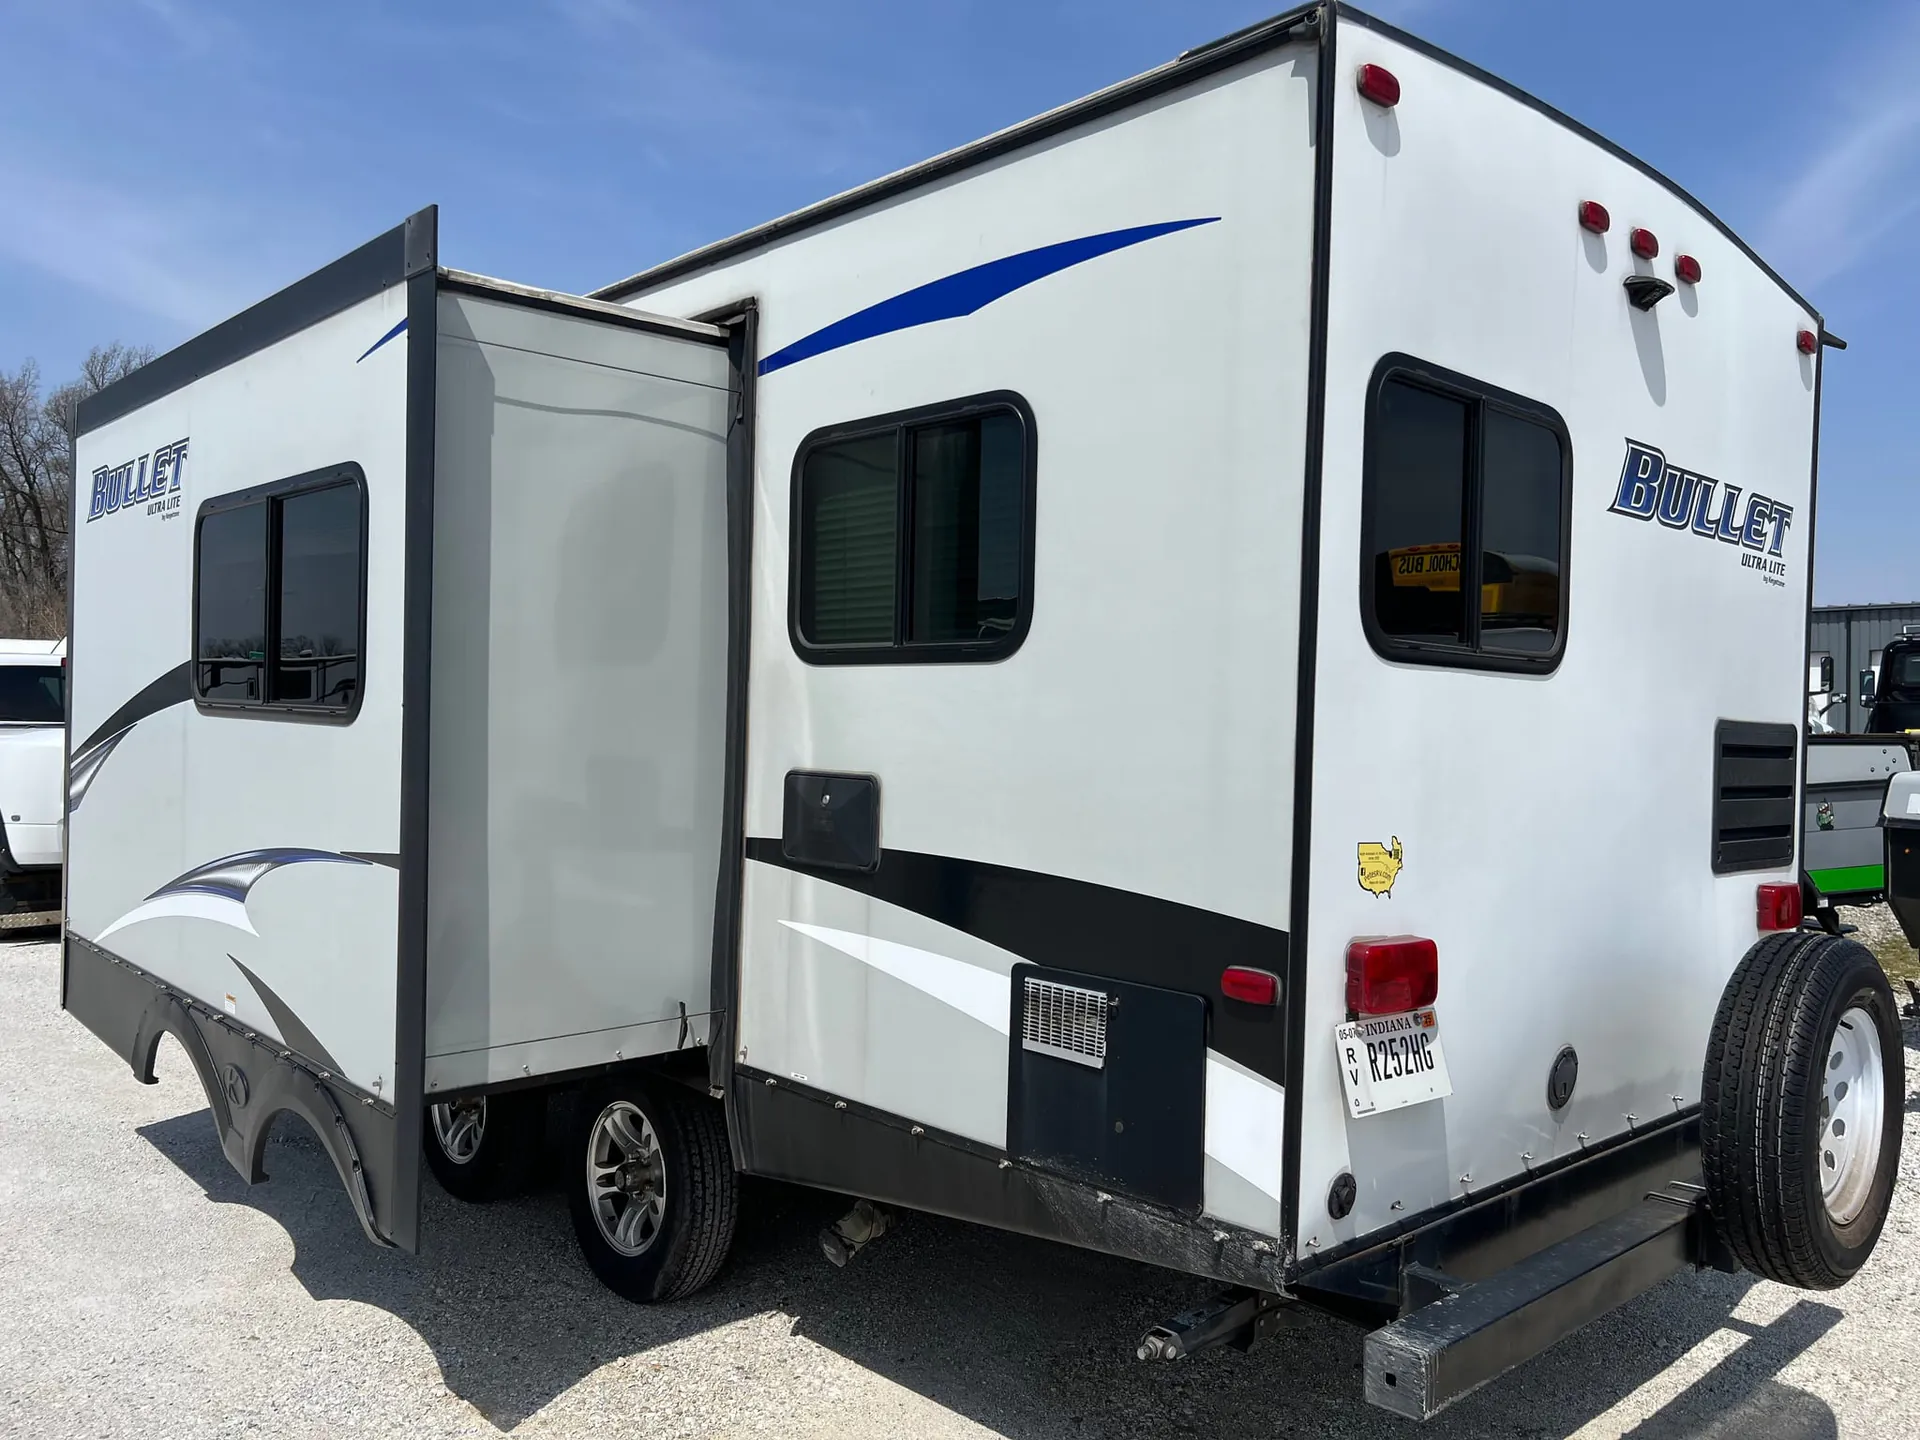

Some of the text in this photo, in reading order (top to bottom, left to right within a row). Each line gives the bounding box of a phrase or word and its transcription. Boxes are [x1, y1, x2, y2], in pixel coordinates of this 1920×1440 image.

[147, 495, 181, 516] ULTRA LITE
[1741, 552, 1786, 577] ULTRA LITE
[1365, 1017, 1412, 1036] INDIANA
[1366, 1032, 1435, 1083] R252HG
